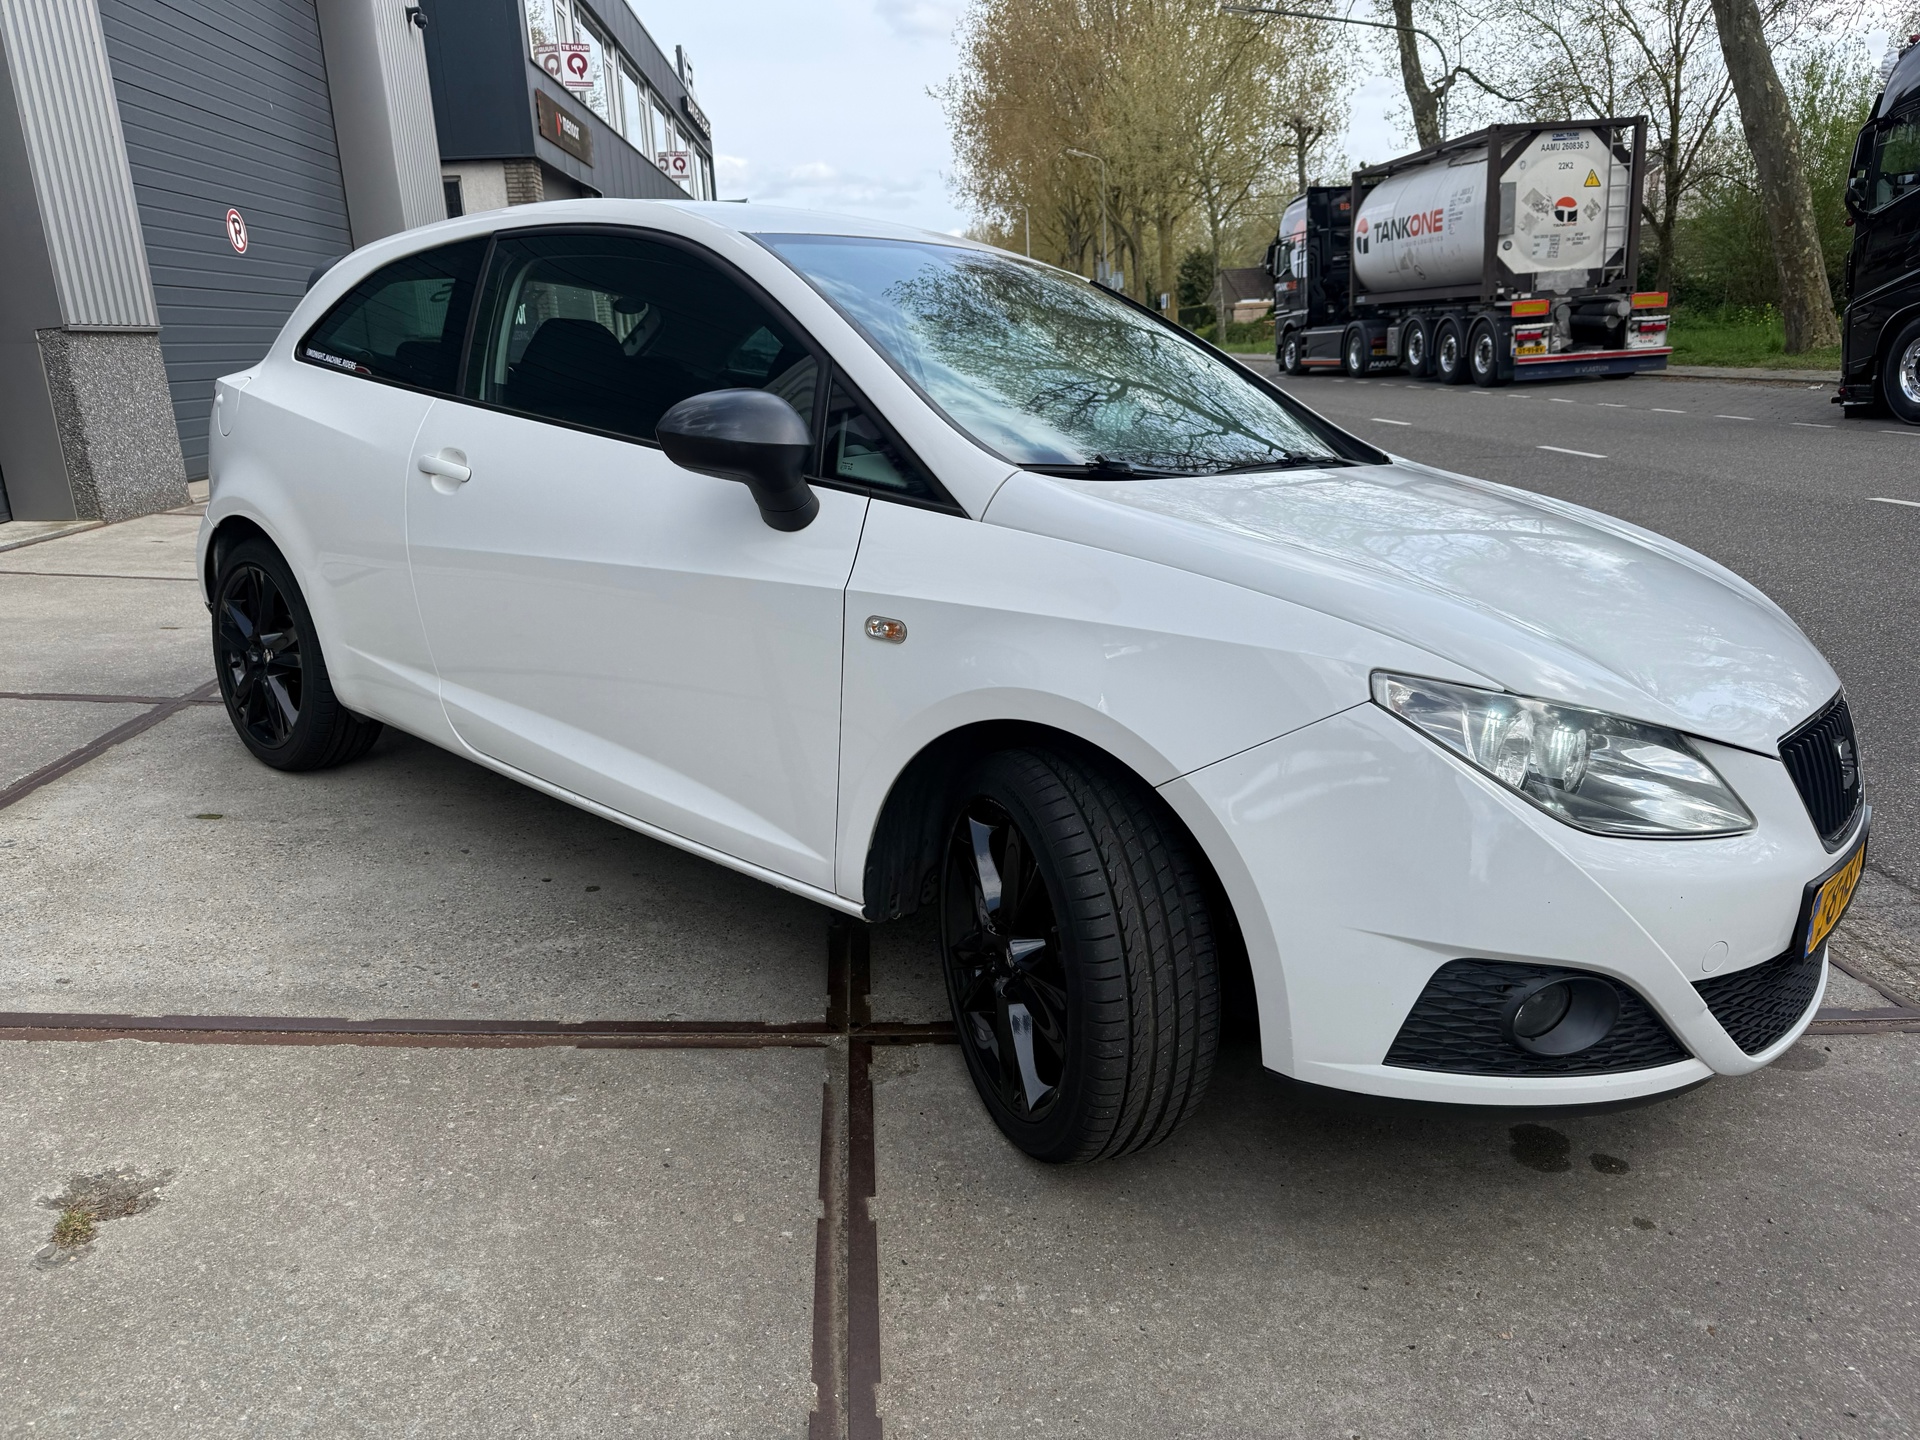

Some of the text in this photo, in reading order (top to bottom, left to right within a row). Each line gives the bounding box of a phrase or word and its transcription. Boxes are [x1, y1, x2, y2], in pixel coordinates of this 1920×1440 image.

[1541, 140, 1590, 151] AAMU 260836 3
[1558, 161, 1574, 170] 22K2
[1374, 208, 1444, 244] TANKONE
